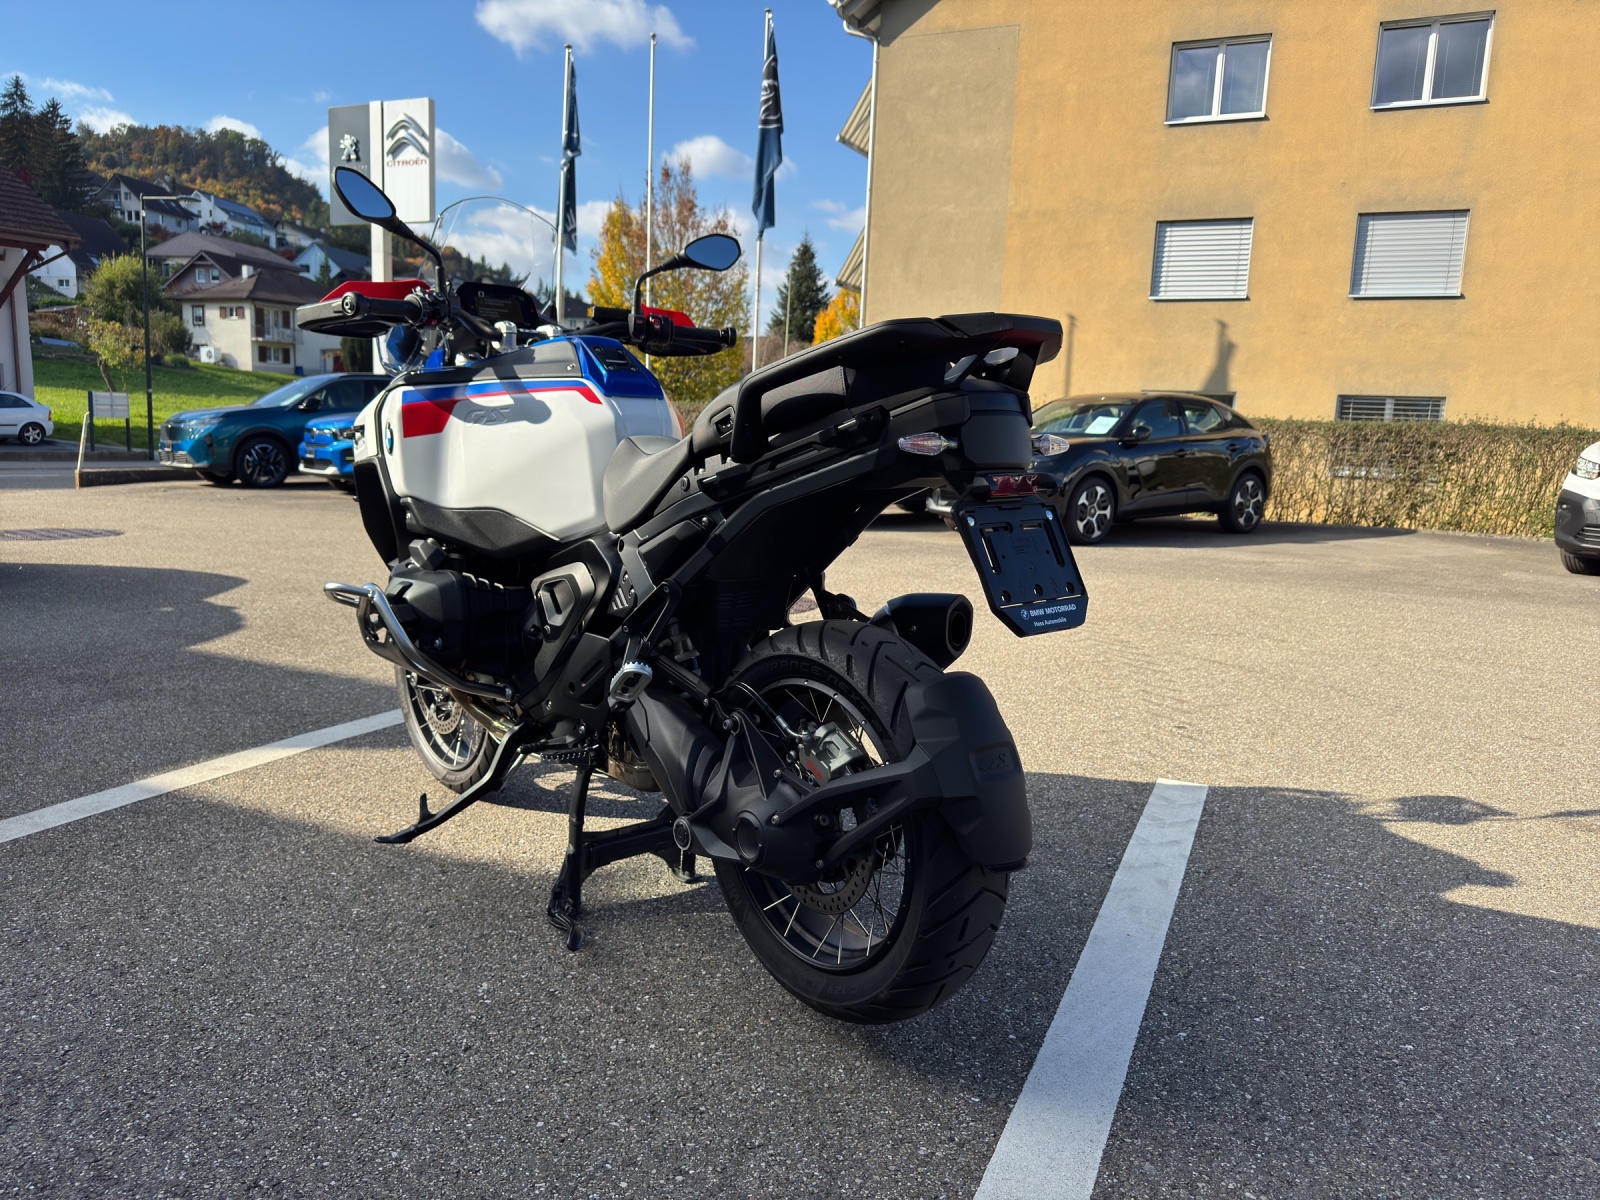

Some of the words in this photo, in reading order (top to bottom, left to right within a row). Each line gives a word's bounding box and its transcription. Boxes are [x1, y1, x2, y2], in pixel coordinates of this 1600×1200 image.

[386, 157, 428, 168] CITROËN
[1029, 608, 1045, 617] BMW
[1045, 603, 1077, 615] MOTORRAD
